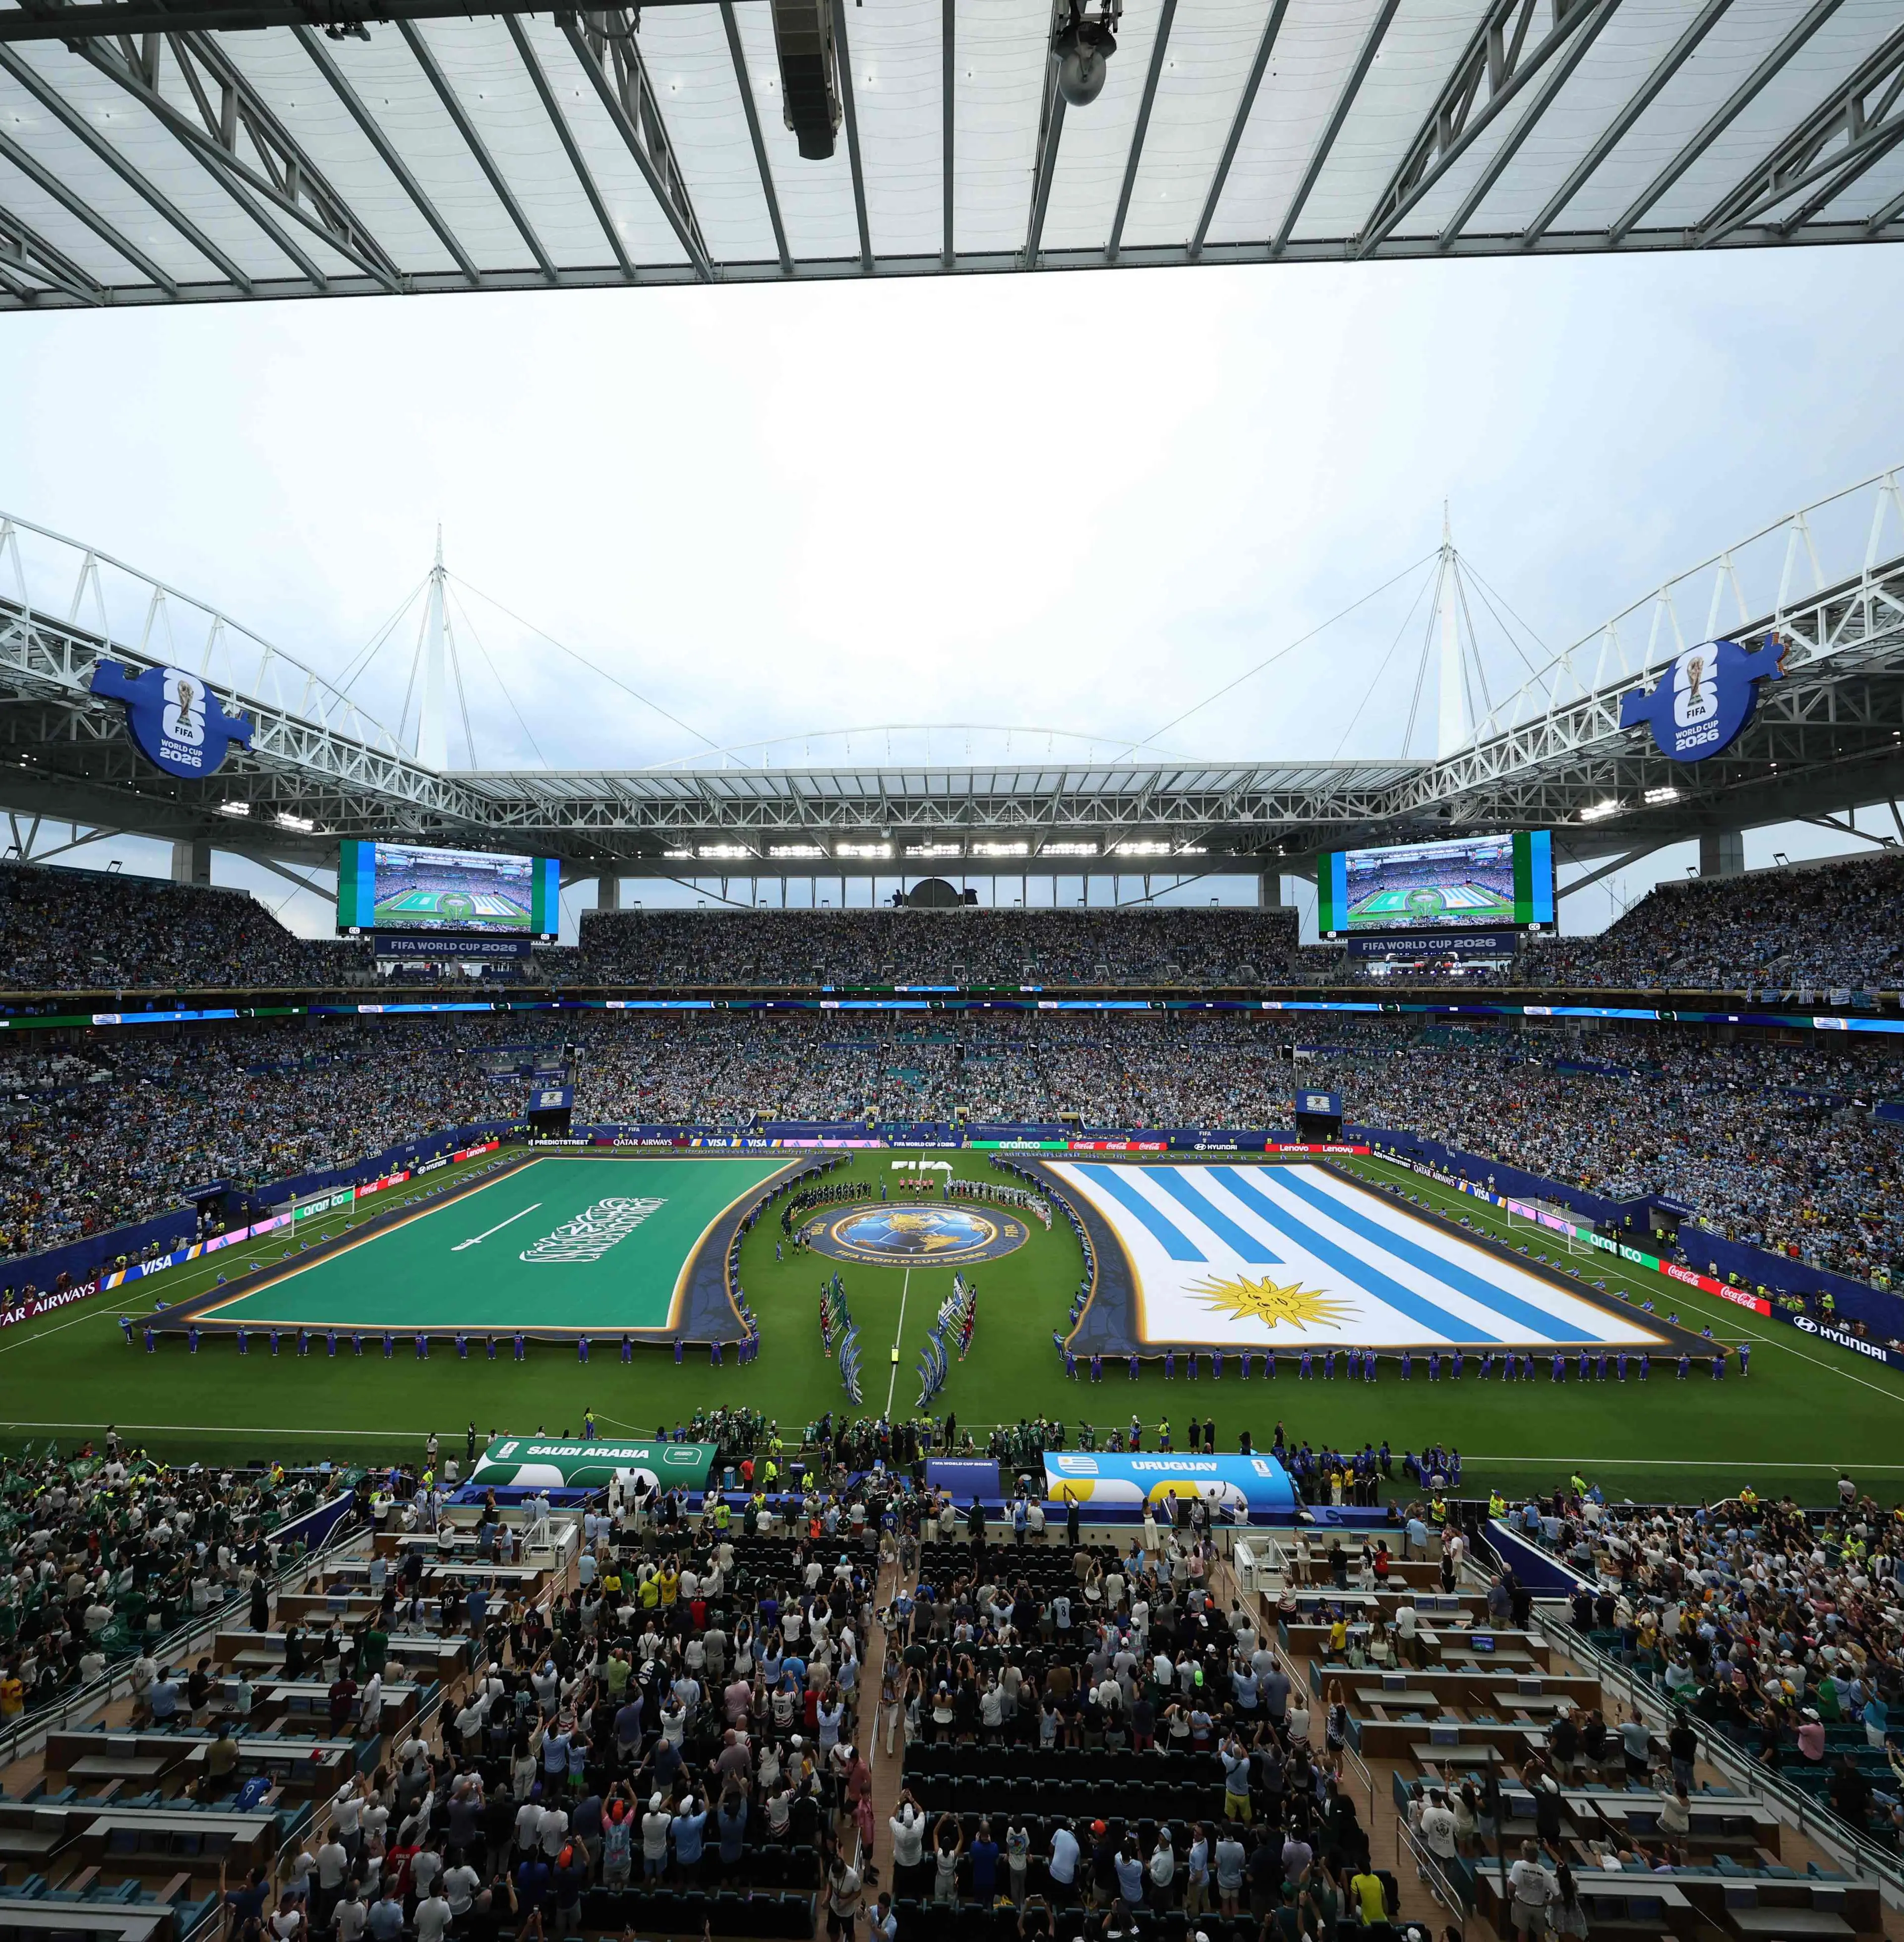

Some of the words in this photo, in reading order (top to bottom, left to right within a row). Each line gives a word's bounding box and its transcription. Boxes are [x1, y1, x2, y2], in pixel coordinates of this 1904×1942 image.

[1687, 706, 1706, 718] FIFA
[175, 726, 193, 738] FIFA
[1675, 726, 1702, 739] WORLD
[1703, 720, 1719, 730] CUP
[1675, 729, 1719, 751] 2026
[161, 739, 188, 753] WORLD
[189, 748, 203, 757] CUP
[160, 747, 202, 767] 2026
[391, 941, 416, 949] FIFA
[417, 942, 456, 951] WORLD
[459, 943, 480, 951] CUP
[481, 943, 517, 952] 2026
[1387, 941, 1427, 949] WORLD
[1428, 940, 1452, 948] CUP
[1454, 939, 1496, 947] 2026
[467, 1146, 486, 1158] Lenovo
[1322, 1145, 1353, 1153] Lenovo
[426, 1159, 447, 1171] HYUNDAI
[891, 1161, 953, 1170] FIFA
[1373, 1150, 1383, 1159] ADI
[1383, 1154, 1411, 1169] PREDICTSTREET
[1414, 1165, 1431, 1177] QATAR
[1432, 1171, 1455, 1187] AIRWAYS
[1473, 1186, 1490, 1202] VISA
[1003, 1224, 1018, 1237] FIFA
[835, 1250, 859, 1260] FIFA
[862, 1256, 910, 1264] WORLD
[943, 1252, 988, 1263] 2026
[138, 1254, 173, 1276] VISA
[1667, 1265, 1701, 1287] Coca-Cola
[32, 1282, 96, 1315] AIRWAYS
[1720, 1286, 1758, 1309] Coca-Cola
[1820, 1325, 1887, 1361] HYUNDAI
[527, 1446, 582, 1456] SAUDI
[581, 1448, 649, 1459] ARABIA
[1131, 1461, 1217, 1471] URUGUAY
[886, 1518, 893, 1527] 10
[444, 1596, 454, 1606] 10
[1061, 1606, 1066, 1617] 8
[135, 1668, 144, 1679] 10
[778, 1705, 784, 1714] 8
[244, 1784, 254, 1800] 9
